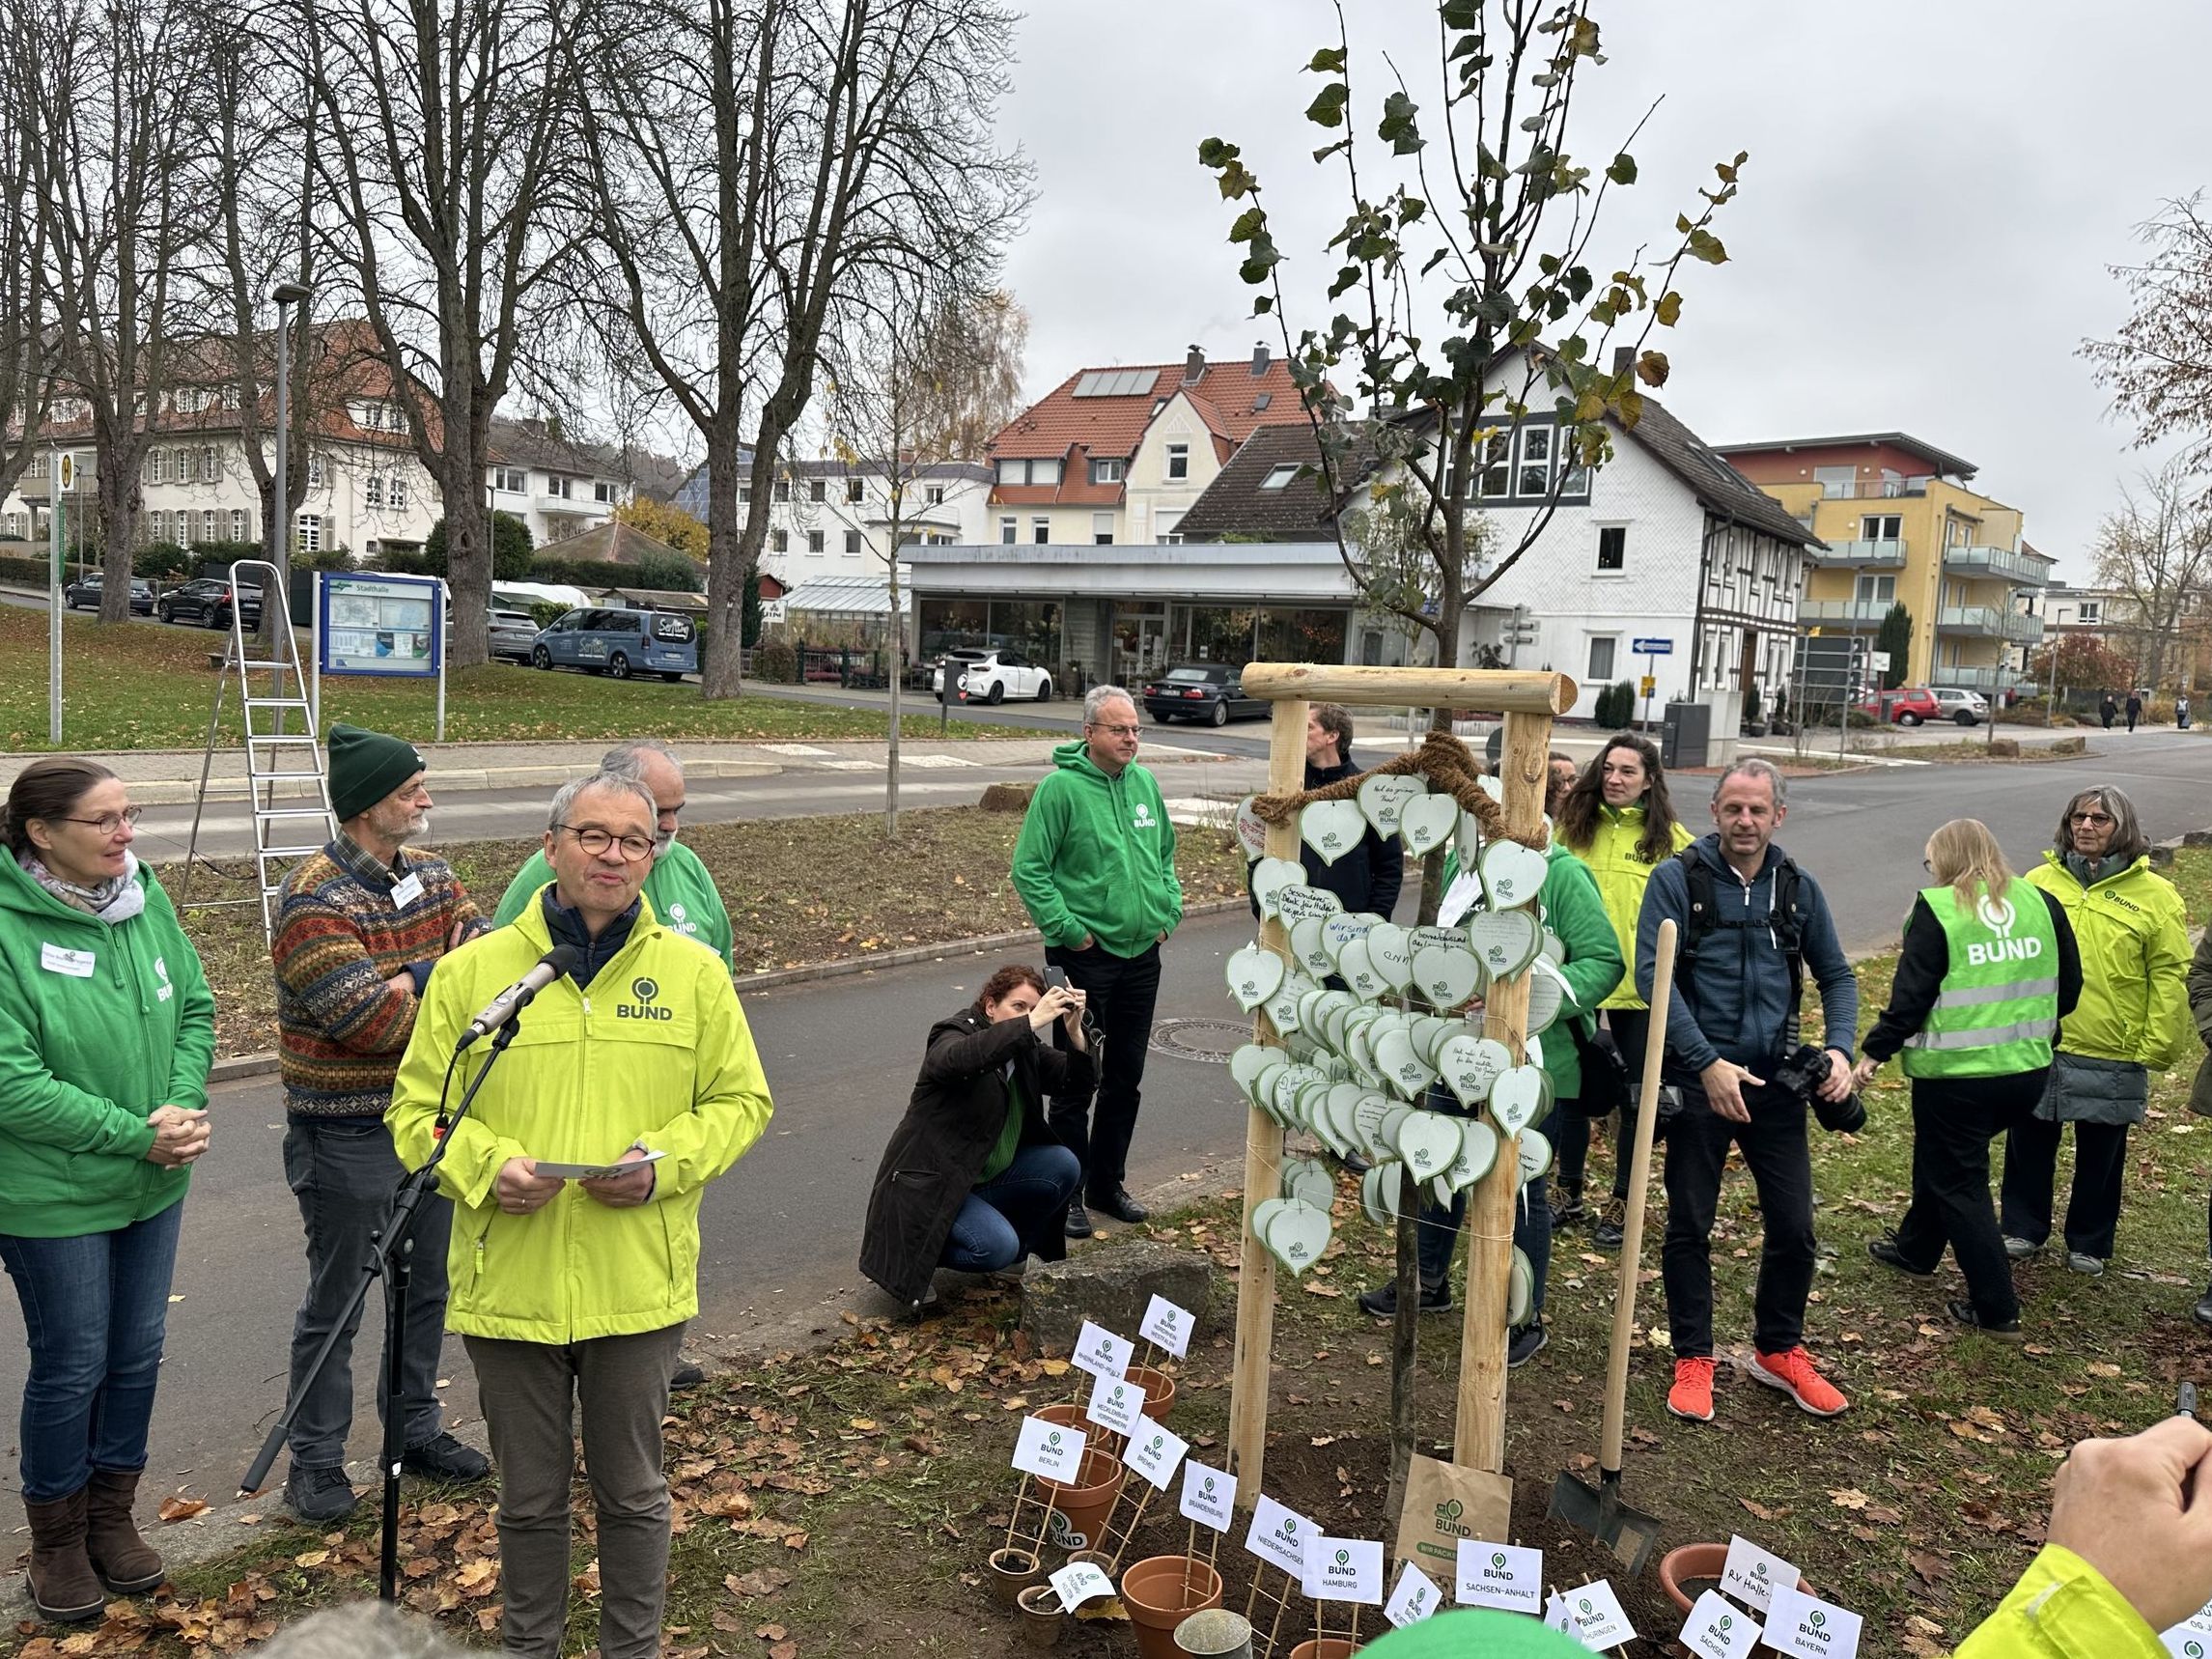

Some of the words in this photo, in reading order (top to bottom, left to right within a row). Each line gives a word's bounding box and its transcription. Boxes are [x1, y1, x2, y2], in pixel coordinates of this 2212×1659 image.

[356, 584, 389, 594] Stadthalle
[1134, 819, 1156, 828] BUND
[2113, 895, 2140, 913] BUND
[1967, 936, 2042, 966] BUND
[616, 1003, 673, 1021] BUND
[1160, 1318, 1177, 1332] BUND
[1095, 1349, 1113, 1363] BUND
[1106, 1396, 1125, 1409] BUND
[1040, 1444, 1064, 1456] BUND
[1143, 1445, 1162, 1461] BUND
[1038, 1455, 1059, 1469] BERLIN
[1136, 1453, 1156, 1471] BREMEN
[1197, 1491, 1218, 1504] BUND
[1188, 1500, 1223, 1519] BRANDENBURG
[1435, 1518, 1471, 1537] BUND
[1052, 1532, 1083, 1546] UND
[1274, 1530, 1299, 1547] BUND
[1328, 1565, 1356, 1576] BUND
[1483, 1569, 1514, 1581] BUND
[1750, 1570, 1769, 1586] BUND
[1322, 1579, 1358, 1589] HAMBURG
[1466, 1583, 1535, 1599] SACHSEN-ANHALT
[1408, 1598, 1421, 1616] BUND
[1581, 1613, 1605, 1627] BUND
[1708, 1624, 1731, 1645] BUND
[1799, 1622, 1832, 1643] BUND
[1699, 1634, 1726, 1659] SACHSEN
[1794, 1636, 1828, 1657] BAYERN
